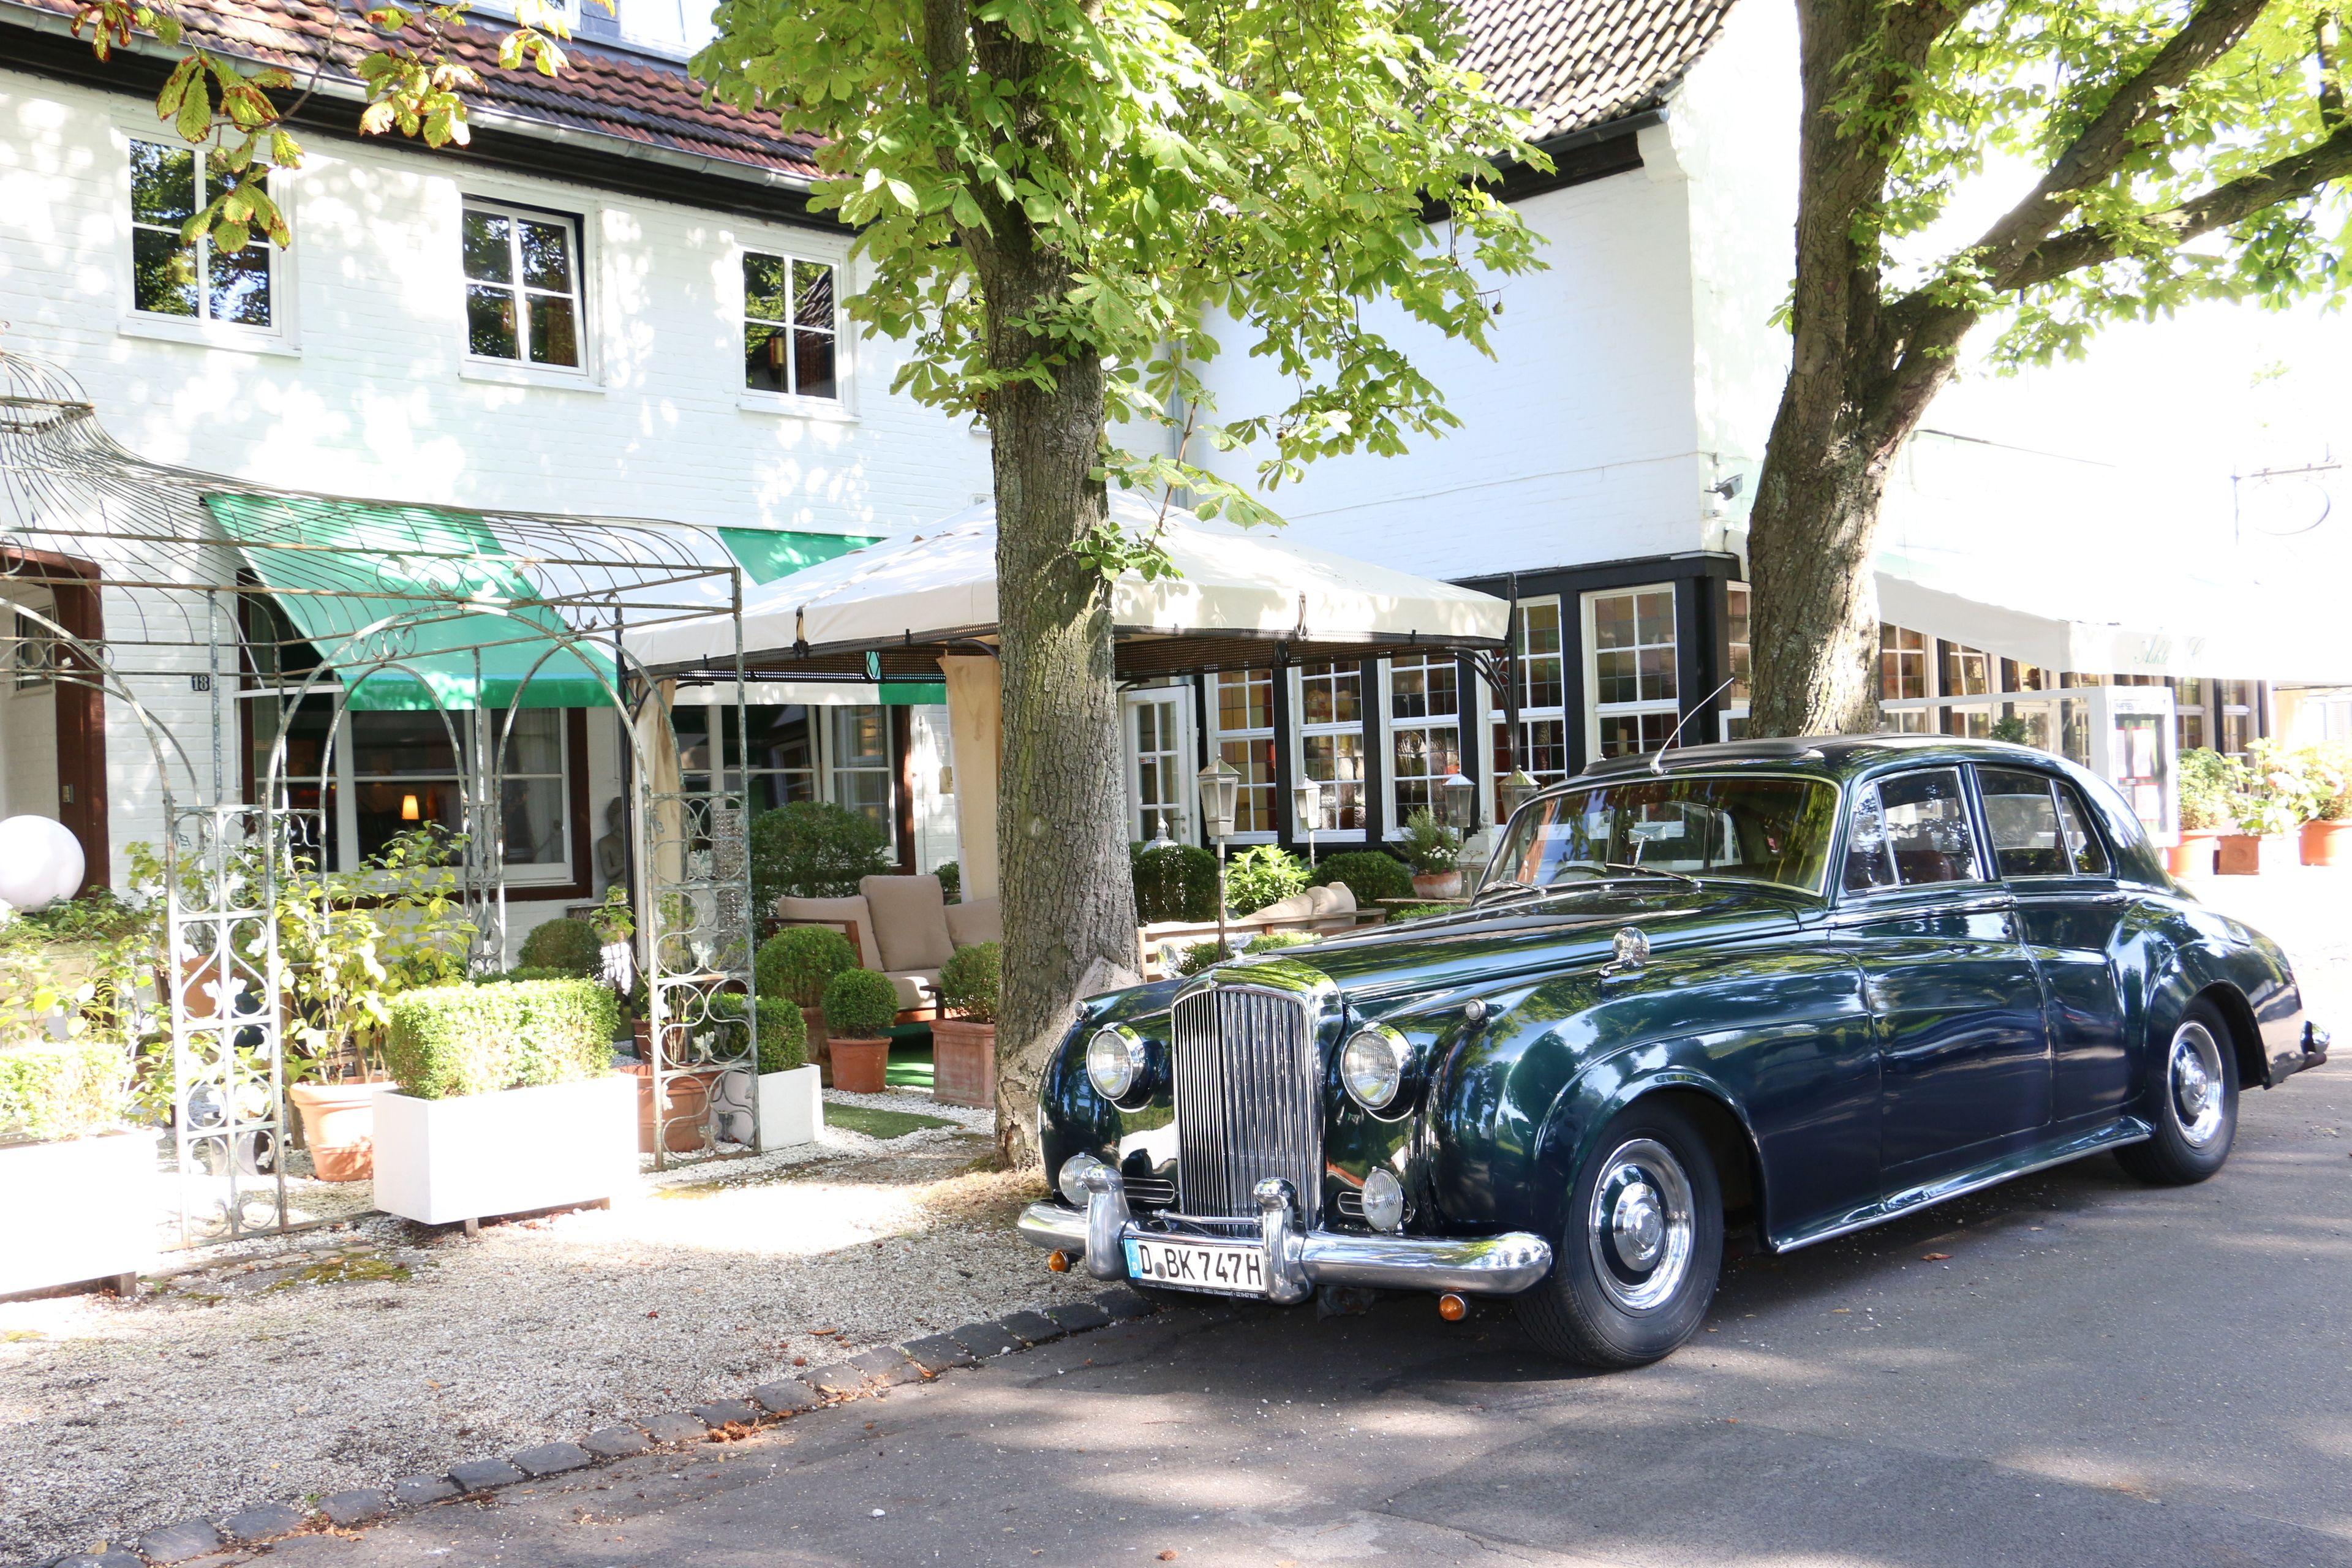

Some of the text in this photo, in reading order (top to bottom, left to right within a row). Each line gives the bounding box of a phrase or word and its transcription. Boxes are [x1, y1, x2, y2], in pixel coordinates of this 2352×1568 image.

[192, 675, 208, 690] 18
[1138, 1245, 1153, 1274] D
[1164, 1248, 1195, 1280] BK
[1197, 1251, 1262, 1286] 747H
